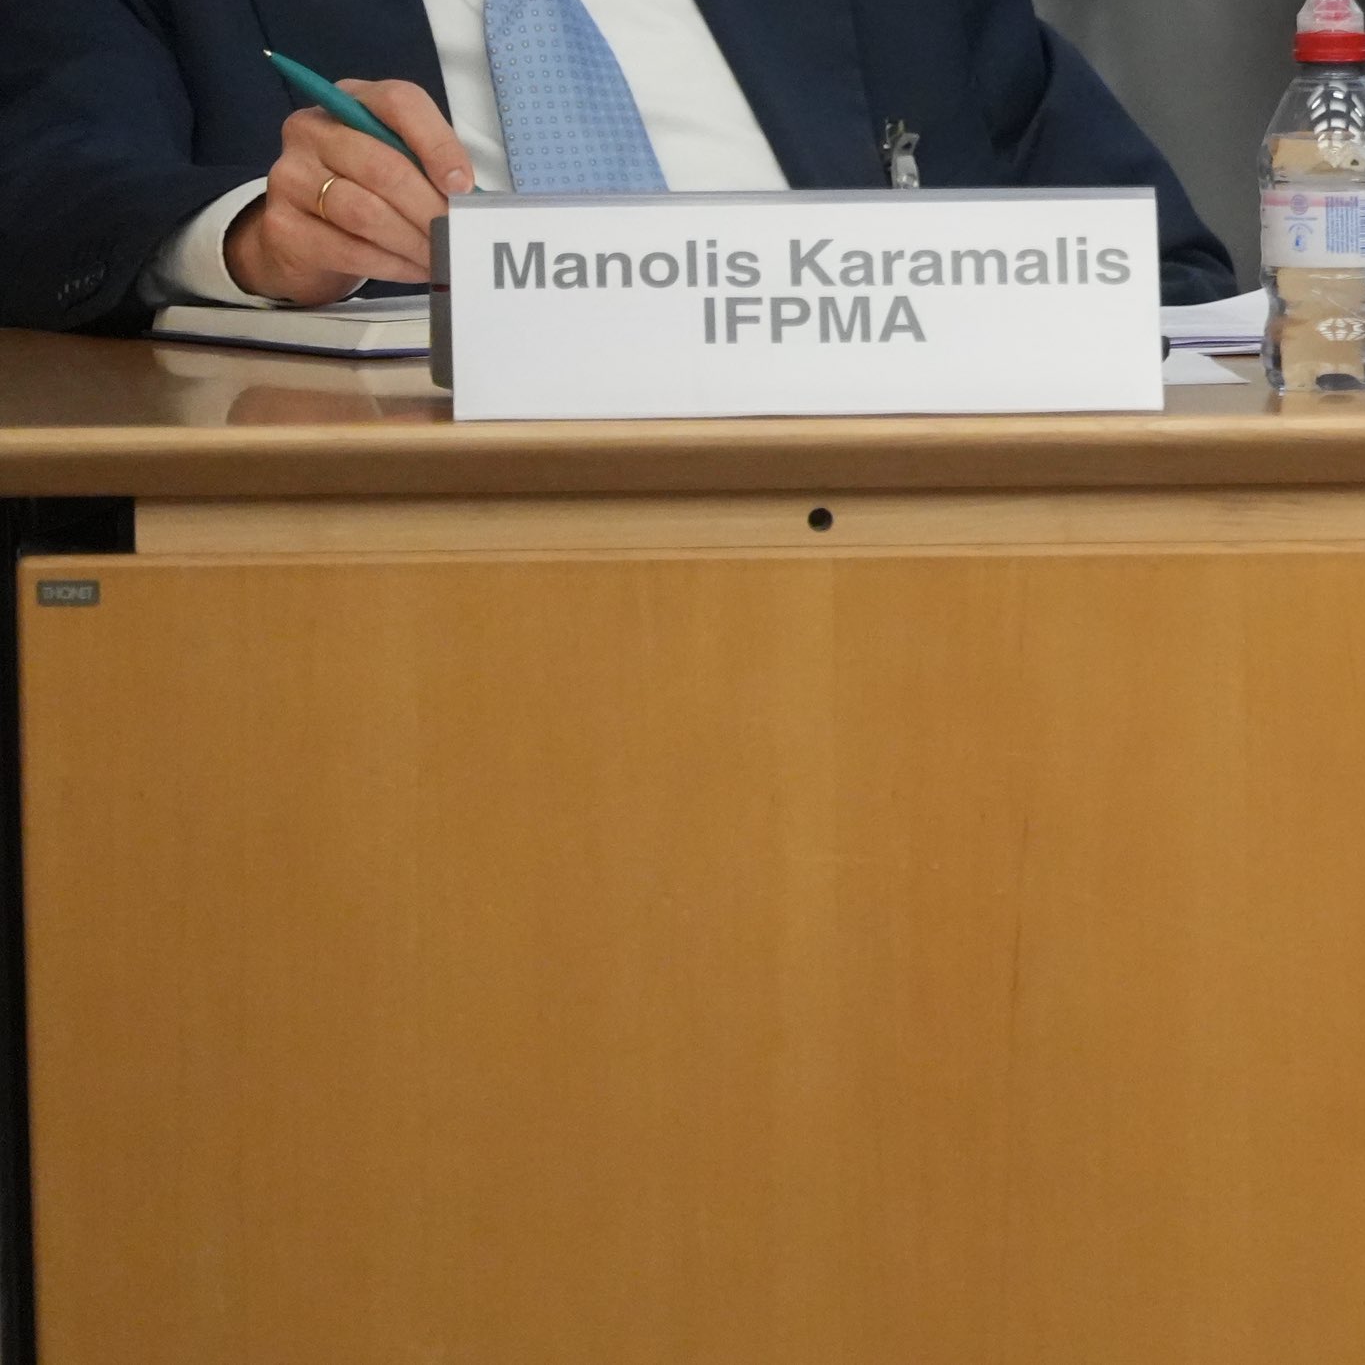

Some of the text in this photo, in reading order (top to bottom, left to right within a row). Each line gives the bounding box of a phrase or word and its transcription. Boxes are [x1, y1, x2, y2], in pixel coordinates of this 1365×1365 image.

[492, 237, 1131, 290] Manolis Karamalis
[703, 295, 927, 345] IFPMA
